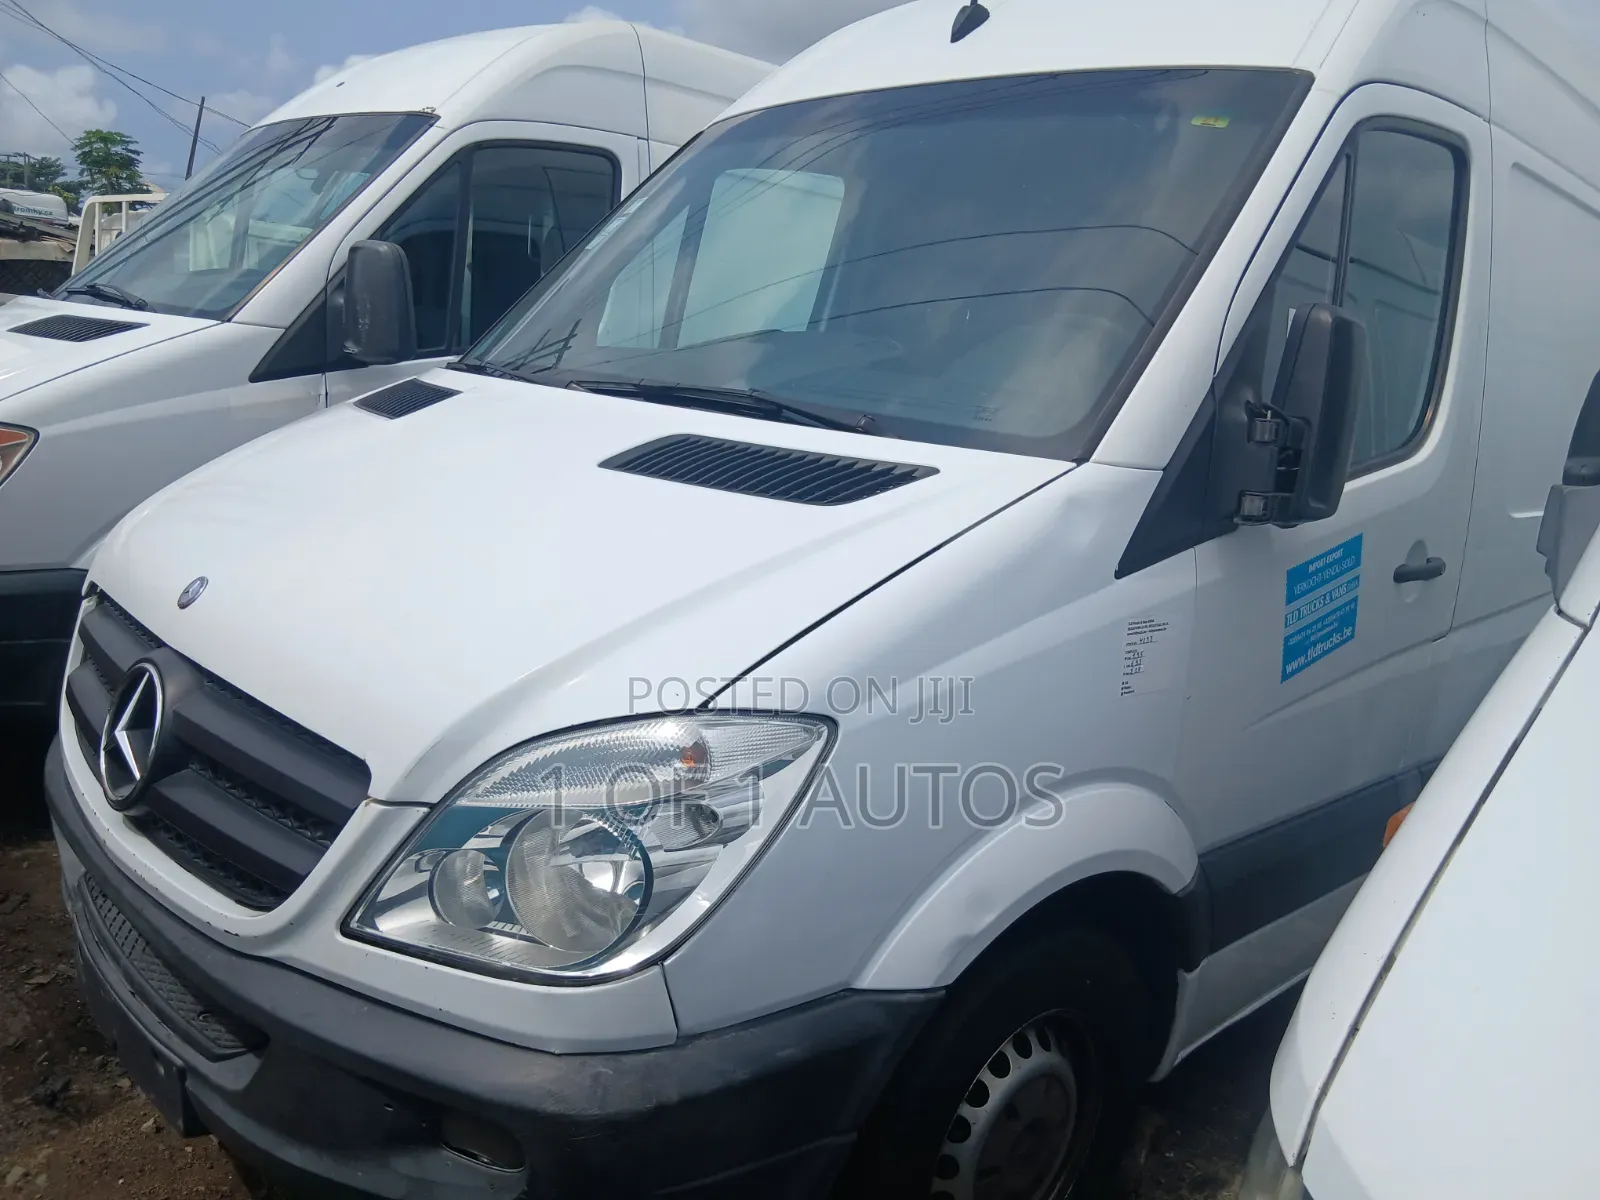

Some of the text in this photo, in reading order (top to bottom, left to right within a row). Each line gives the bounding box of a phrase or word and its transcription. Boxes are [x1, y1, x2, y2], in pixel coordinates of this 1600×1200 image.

[1286, 610, 1299, 627] TLD
[1300, 596, 1325, 619] TRUCKS
[1331, 583, 1347, 600] VANS
[1285, 626, 1353, 675] www.tldtrucks.be
